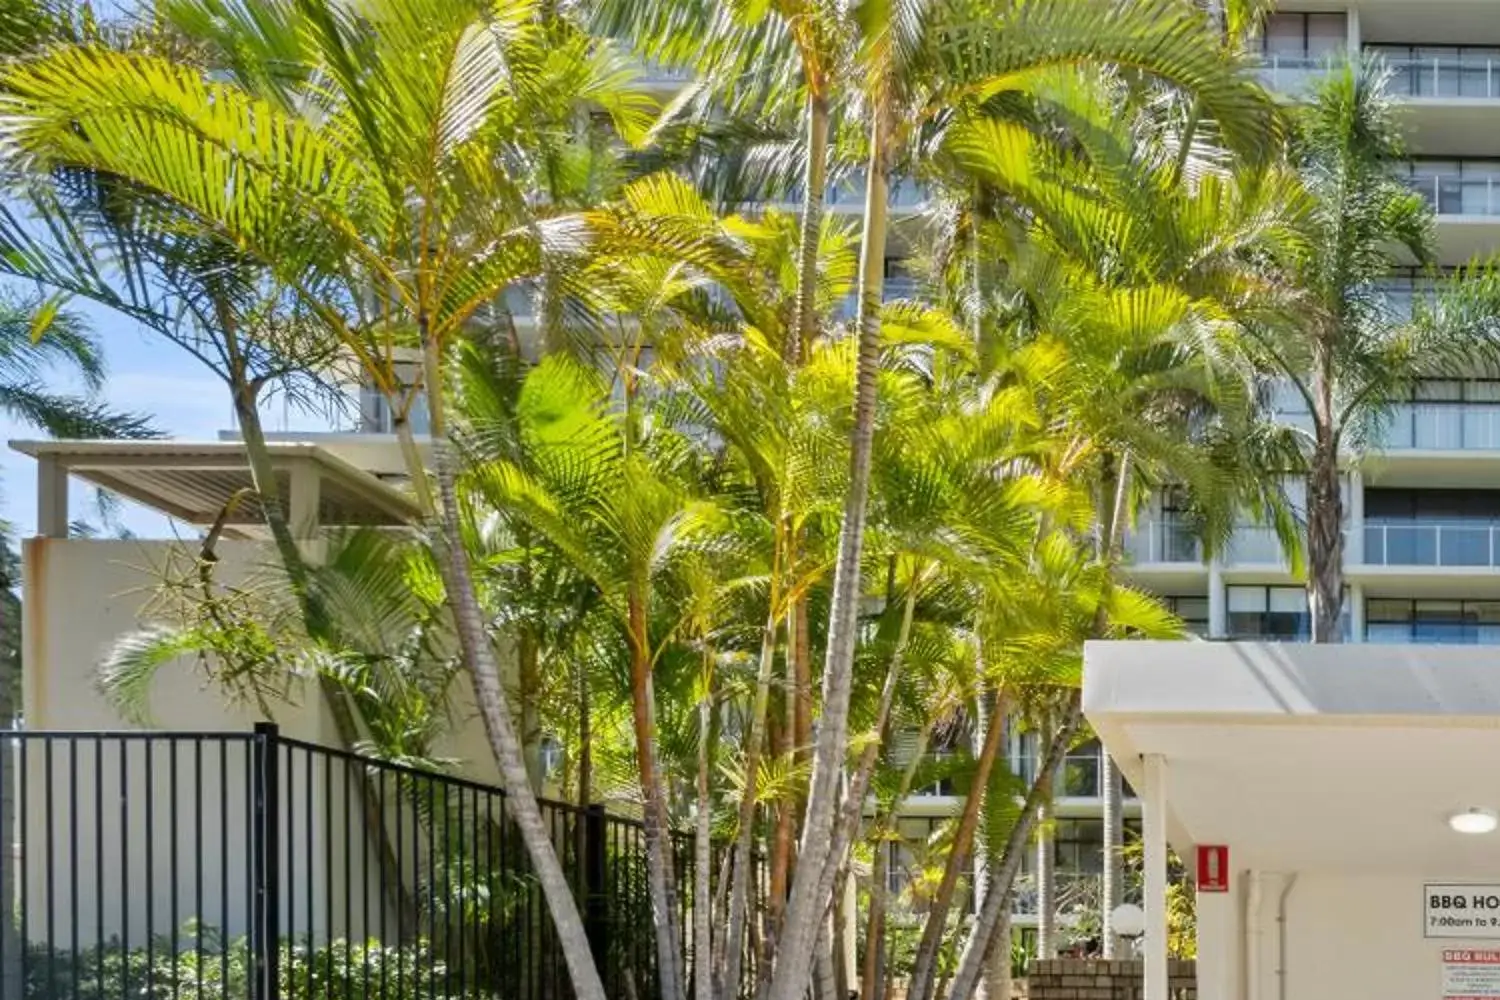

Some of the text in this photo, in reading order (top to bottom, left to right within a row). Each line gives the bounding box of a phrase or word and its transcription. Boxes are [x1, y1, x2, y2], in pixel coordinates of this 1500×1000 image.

[1430, 895, 1467, 909] BBQ
[1475, 917, 1487, 927] to
[1445, 951, 1471, 961] BBQ
